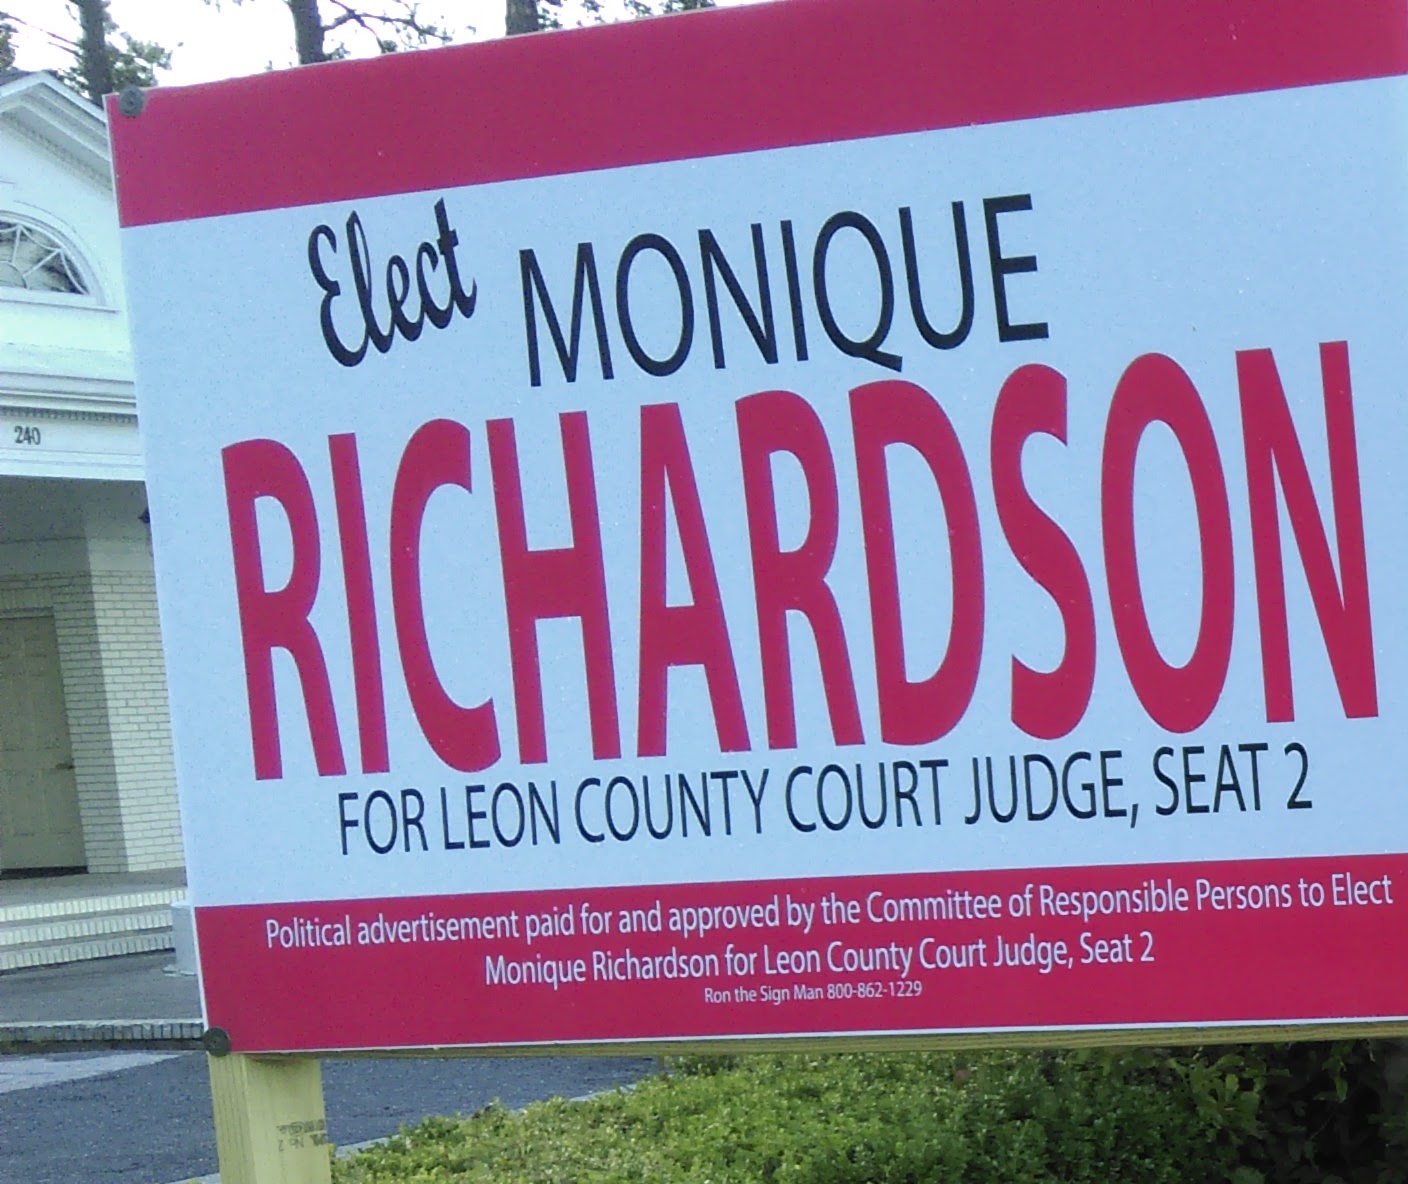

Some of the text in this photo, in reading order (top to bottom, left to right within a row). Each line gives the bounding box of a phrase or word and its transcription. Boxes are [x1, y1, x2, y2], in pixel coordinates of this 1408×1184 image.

[308, 193, 1050, 387] Elect MONIQUE
[14, 425, 41, 445] 240
[221, 340, 1378, 781] RICHARDSON
[338, 742, 1313, 855] FOR LEON COUNTY COURT JUDGE, SEAT 2
[266, 872, 1394, 948] Political advertisement paid for and approved by the Committee of Responsible Persons to Elect
[485, 930, 1155, 990] Monique Richardson for Leon County Court Judge, Seat 2
[704, 980, 922, 1006] Ron the Sign Man 800-862-1229
